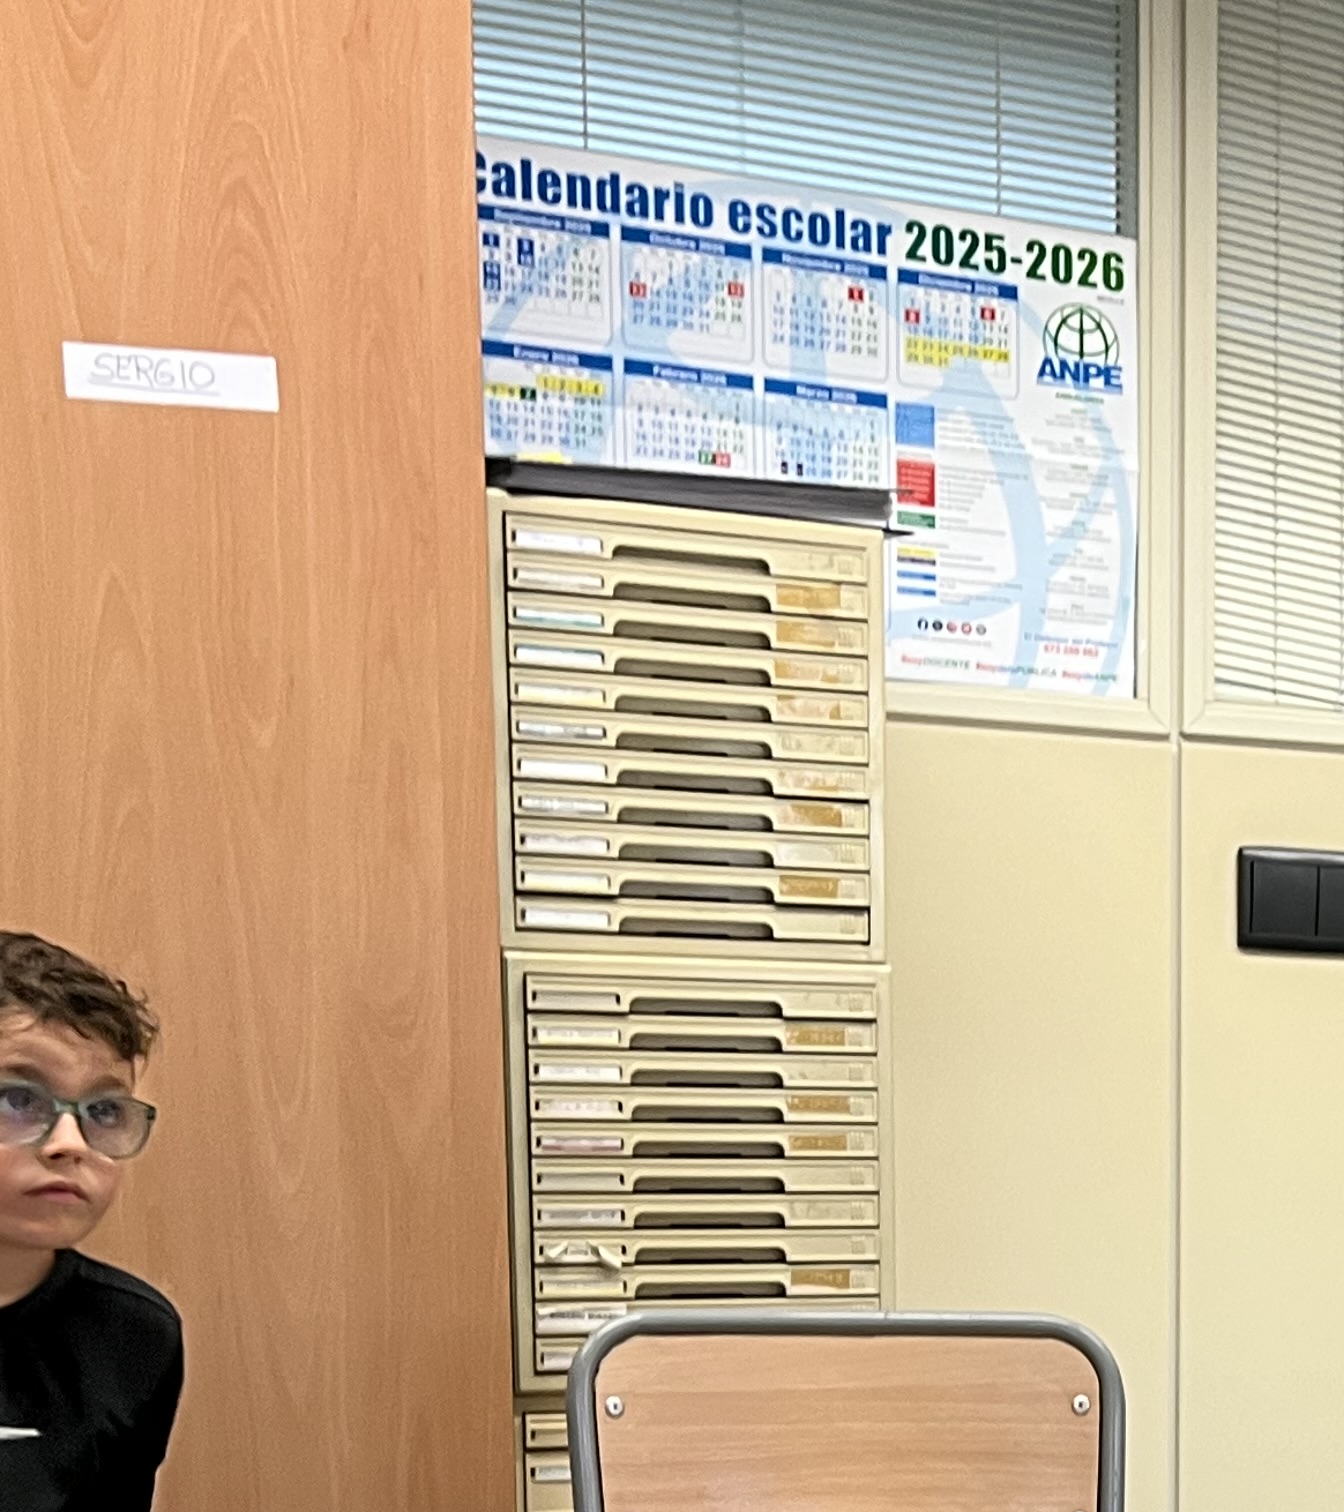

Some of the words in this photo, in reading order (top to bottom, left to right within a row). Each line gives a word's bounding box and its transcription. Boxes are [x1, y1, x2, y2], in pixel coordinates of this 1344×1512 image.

[729, 199, 892, 257] escolar
[904, 219, 1125, 292] 2025-2026
[93, 351, 216, 390] SERGIO
[1037, 356, 1123, 388] ANPE
